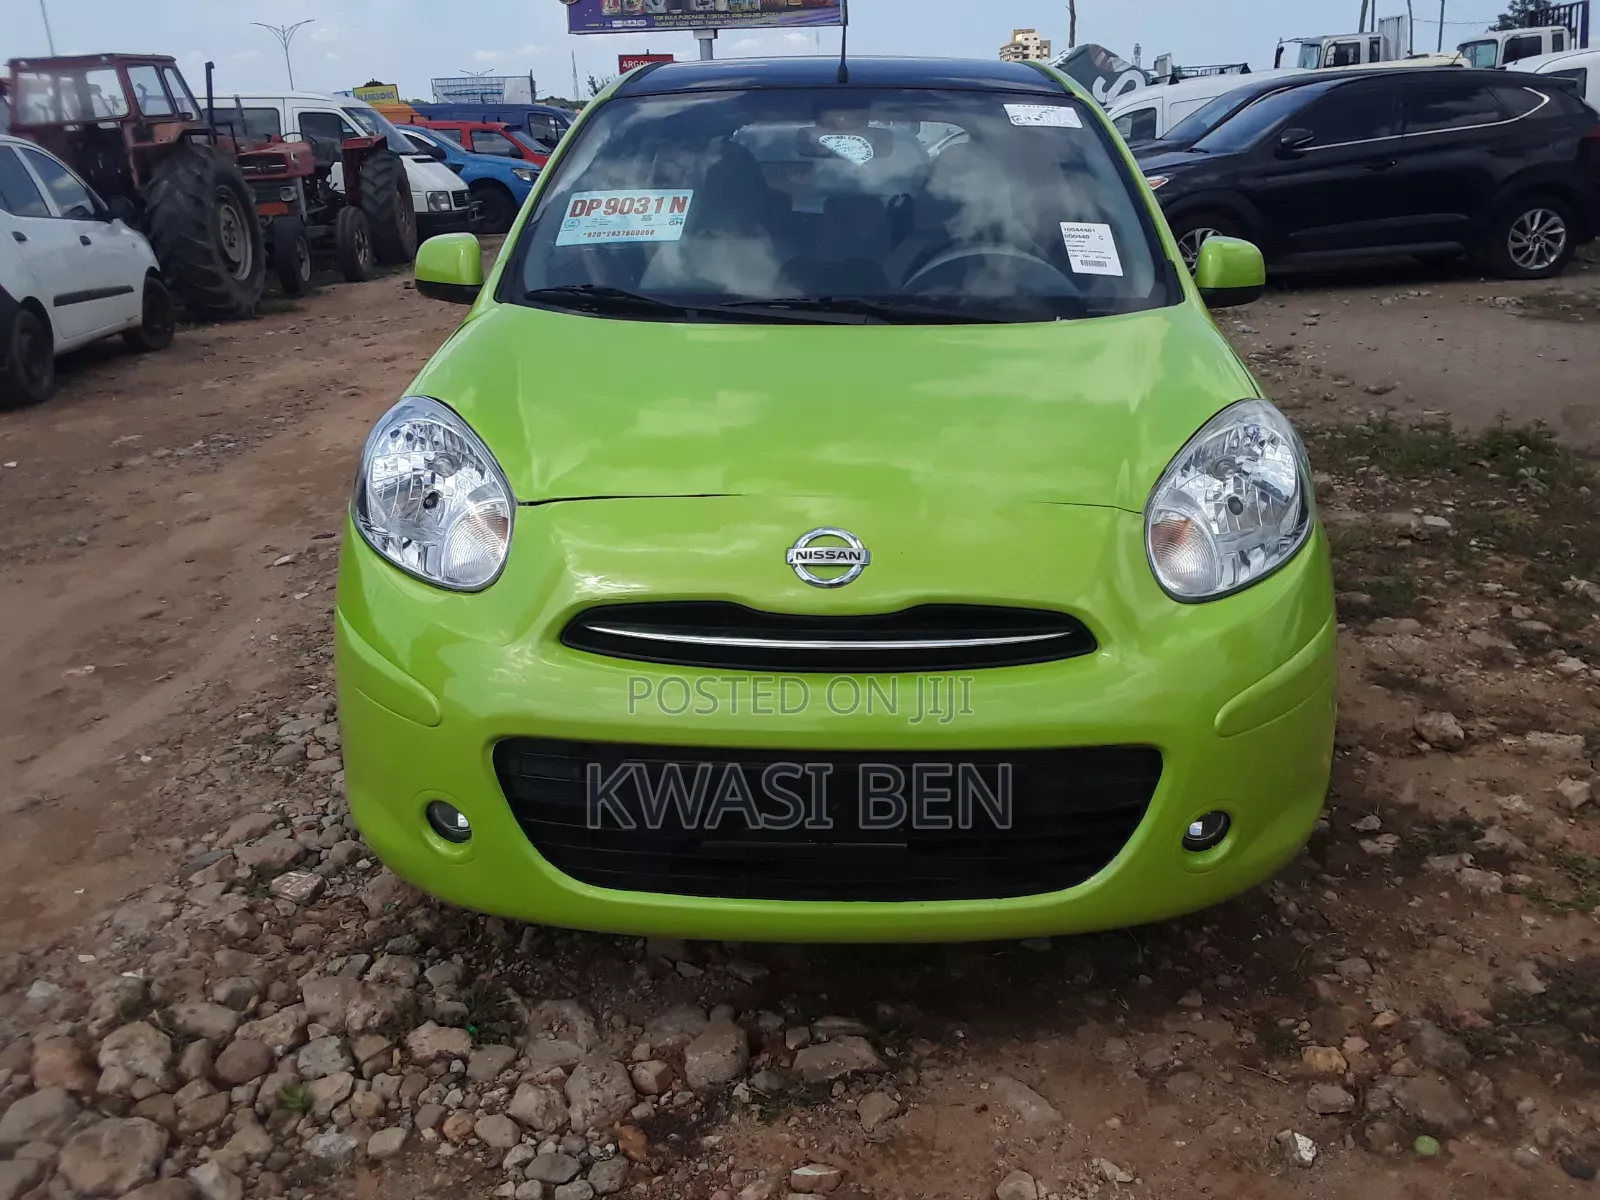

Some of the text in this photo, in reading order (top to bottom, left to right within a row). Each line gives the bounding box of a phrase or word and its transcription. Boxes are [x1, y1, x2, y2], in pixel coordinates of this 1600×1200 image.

[569, 196, 689, 217] DP 9031 N
[795, 550, 861, 561] NISSAN
